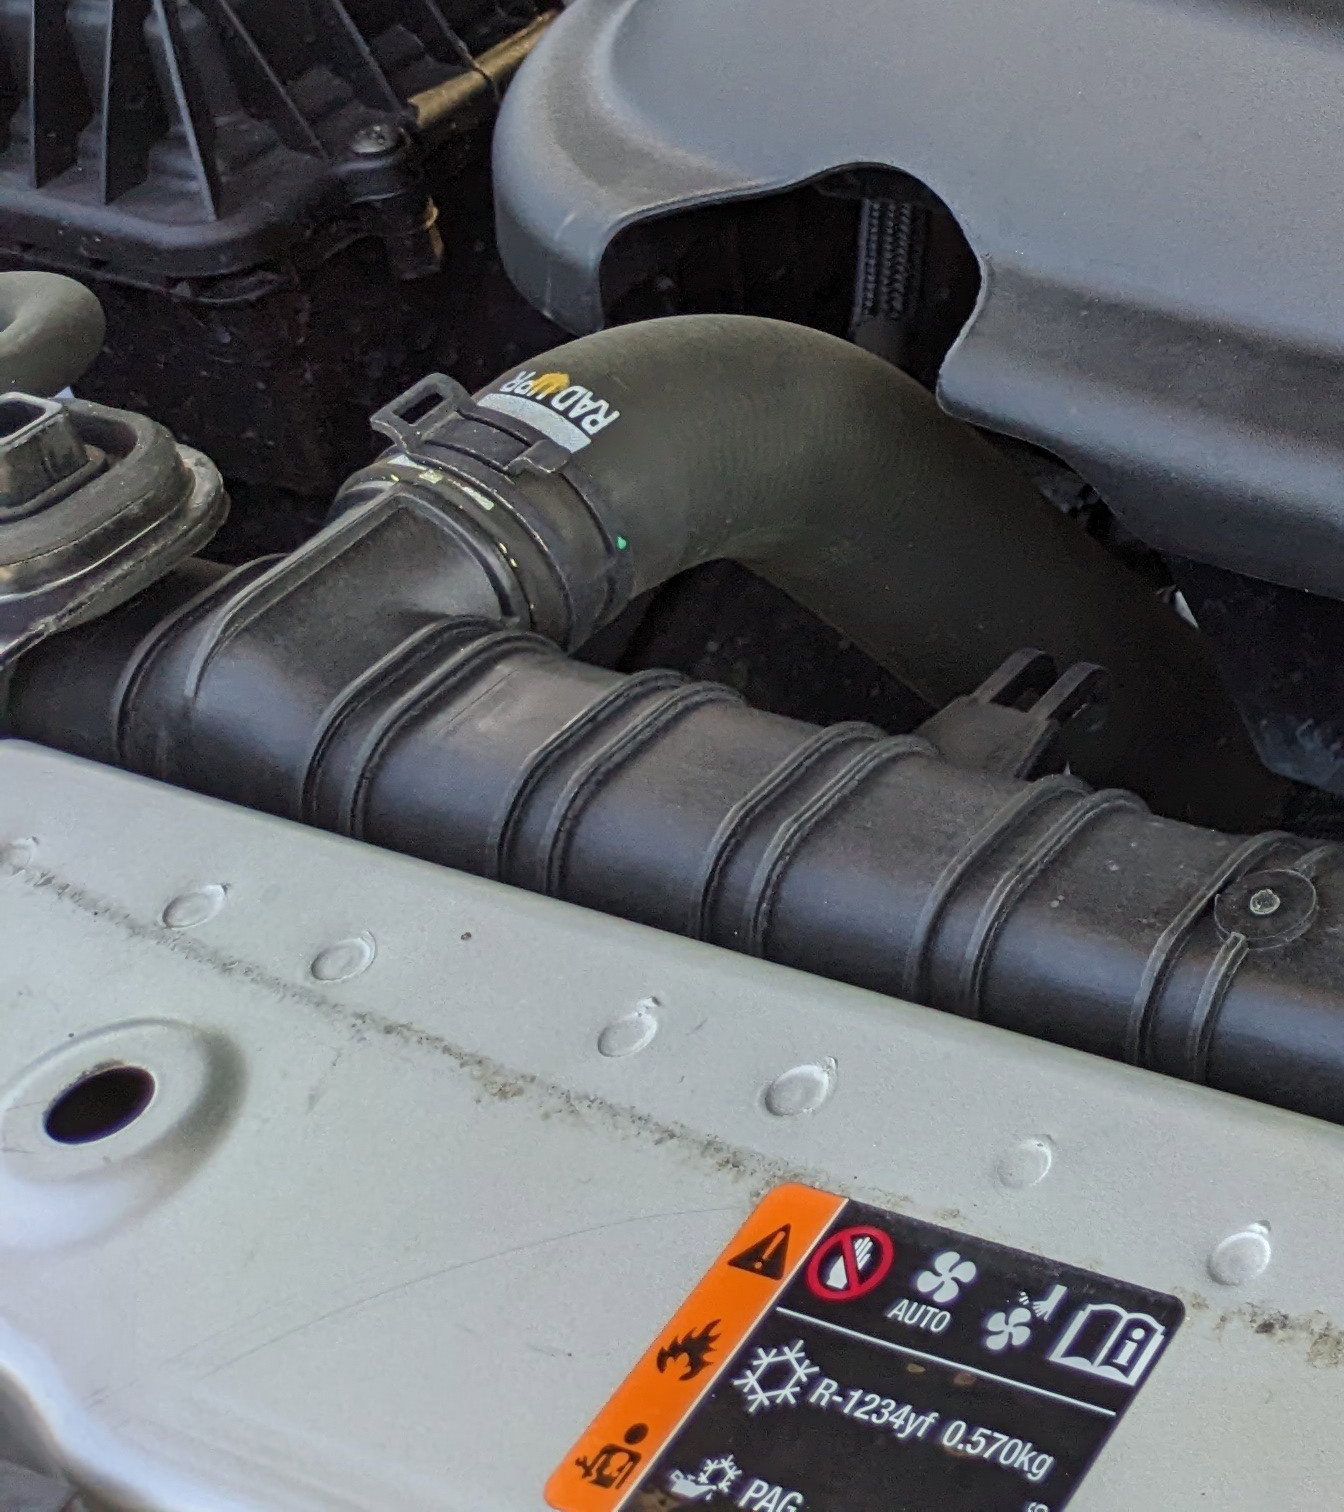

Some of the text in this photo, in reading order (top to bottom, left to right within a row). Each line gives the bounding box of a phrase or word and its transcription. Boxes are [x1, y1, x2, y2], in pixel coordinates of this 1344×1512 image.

[550, 384, 621, 436] RAD
[886, 1298, 953, 1335] AUTO
[807, 1378, 1055, 1482] R-1234yf 0.570kg
[738, 1478, 804, 1512] PAG
